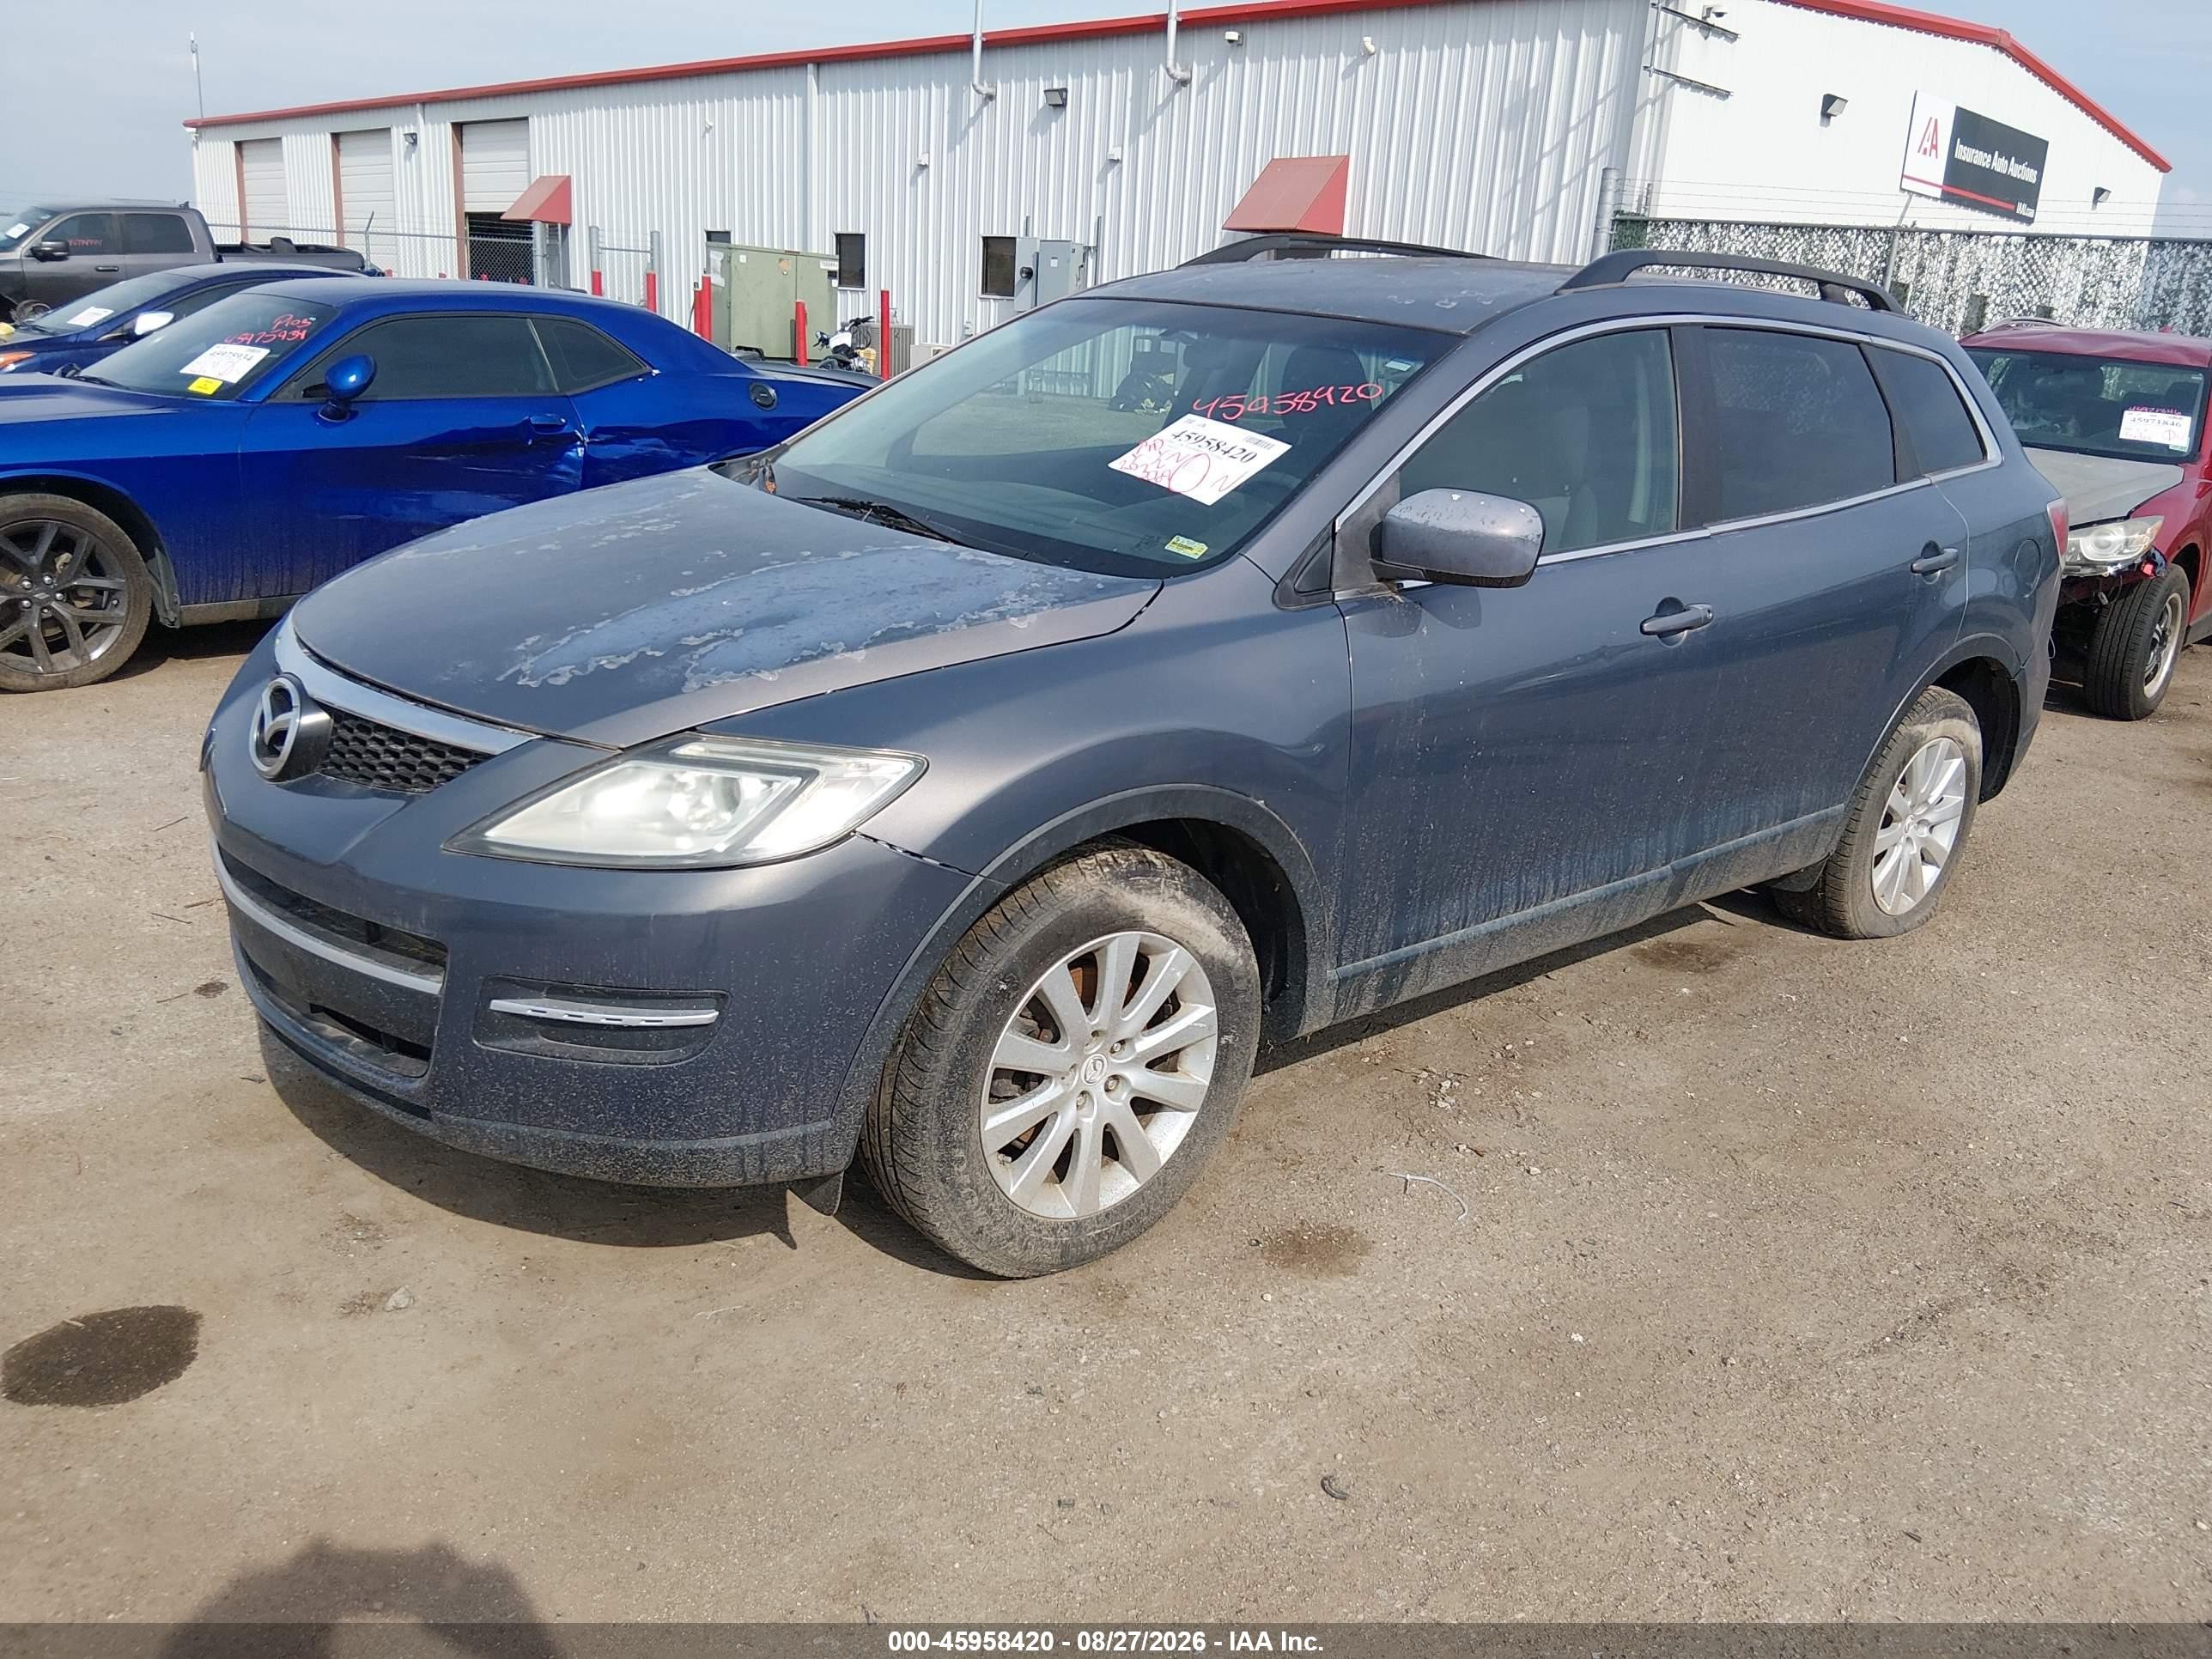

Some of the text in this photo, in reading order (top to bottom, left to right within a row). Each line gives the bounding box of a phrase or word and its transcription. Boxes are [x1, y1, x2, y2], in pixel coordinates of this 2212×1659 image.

[1954, 137, 2038, 185] Insurance Auto Auctions
[1192, 383, 1383, 421] 45958420
[1171, 430, 1258, 464] 45958420
